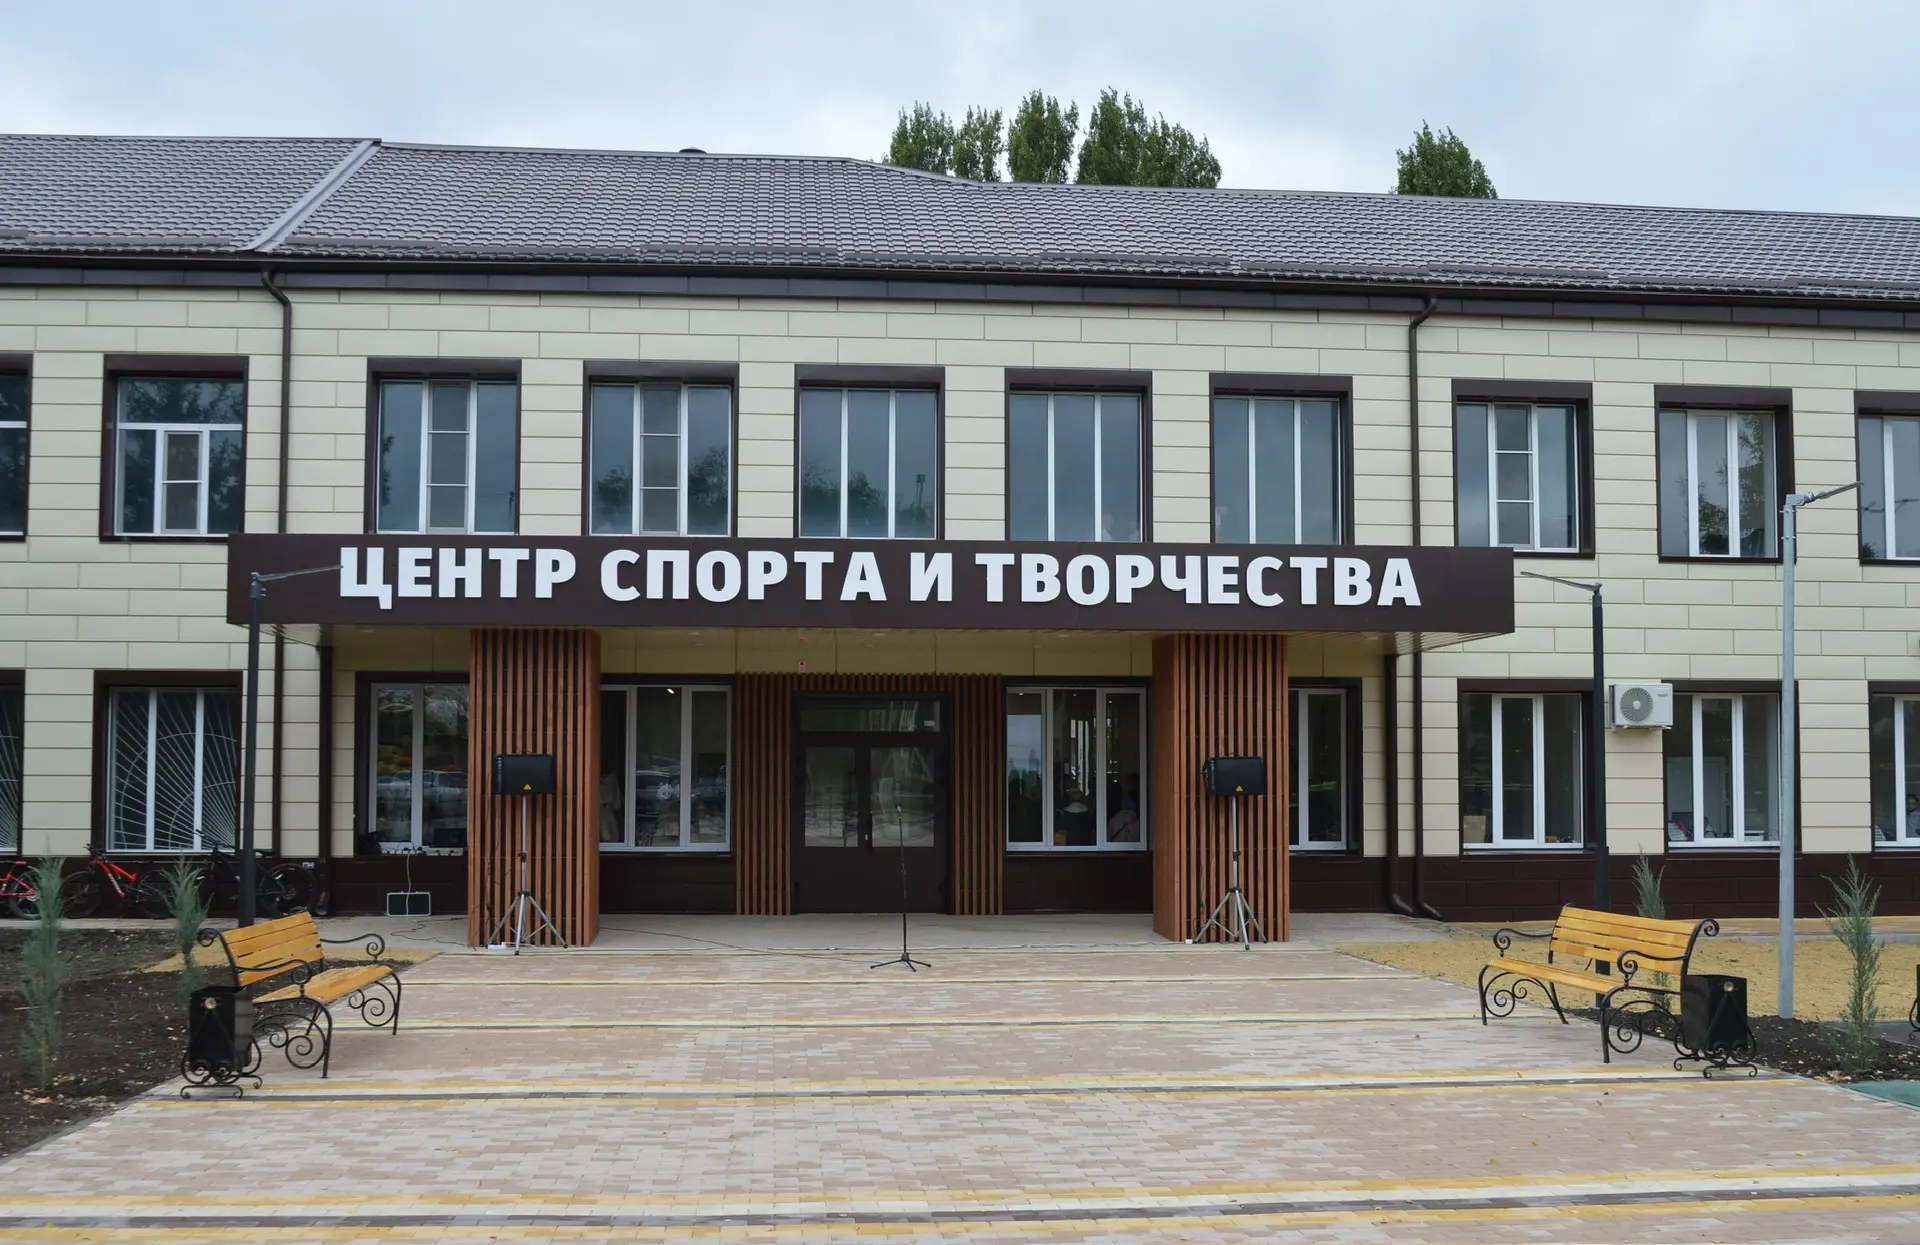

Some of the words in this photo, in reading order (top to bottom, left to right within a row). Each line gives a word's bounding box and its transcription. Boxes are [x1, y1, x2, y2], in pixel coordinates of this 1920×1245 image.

[340, 547, 576, 610] ЦЕНТР
[601, 549, 888, 603] СПОРТА
[910, 552, 953, 602] И
[975, 552, 1422, 608] ТВОРЧЕСТВА
